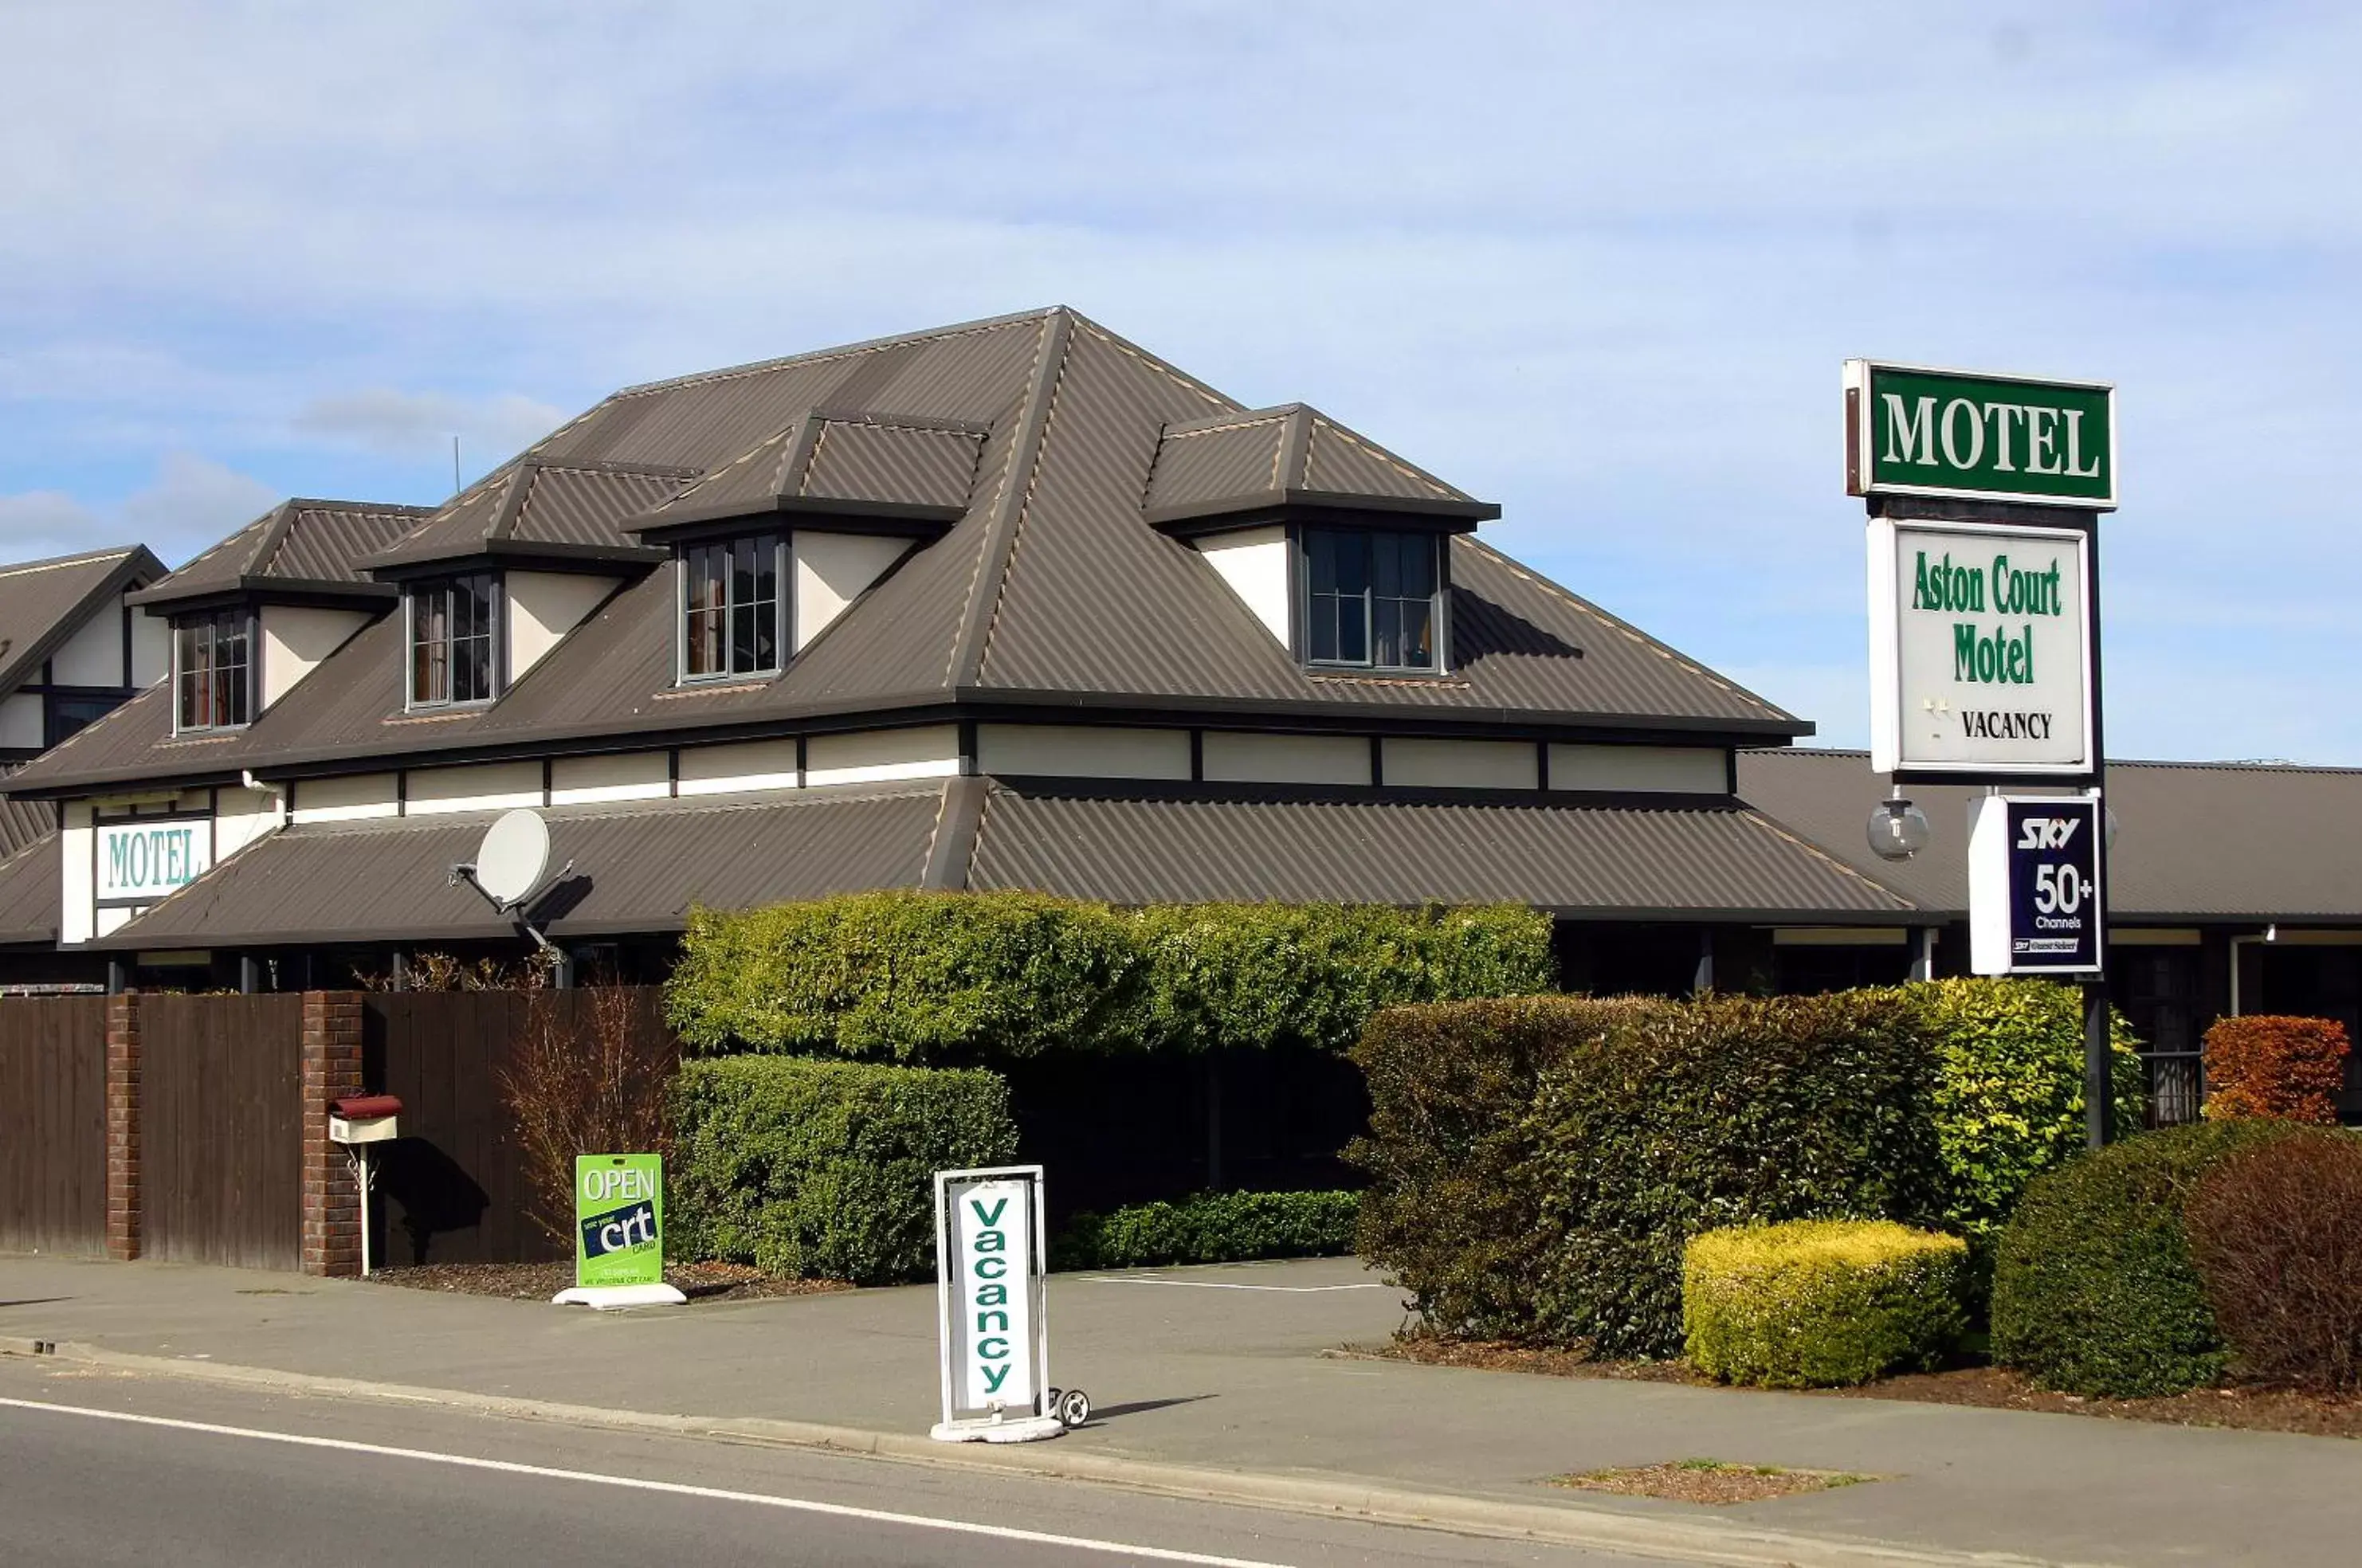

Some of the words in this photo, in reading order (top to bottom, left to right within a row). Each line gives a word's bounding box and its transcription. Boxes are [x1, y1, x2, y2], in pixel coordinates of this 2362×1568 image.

[1881, 393, 2100, 477] MOTEL
[1913, 551, 1985, 613] Aston
[1992, 555, 2062, 616] Court
[1953, 623, 2034, 684] Motel
[1961, 711, 2052, 739] VACANCY
[2017, 818, 2081, 849] SKY
[108, 829, 201, 888] MOTEL
[2034, 864, 2093, 914] 50+
[2035, 915, 2081, 929] Channels
[584, 1169, 655, 1201] OPEN
[601, 1205, 654, 1252] crt
[633, 1241, 656, 1254] CARD
[970, 1198, 1011, 1394] Vacancy
